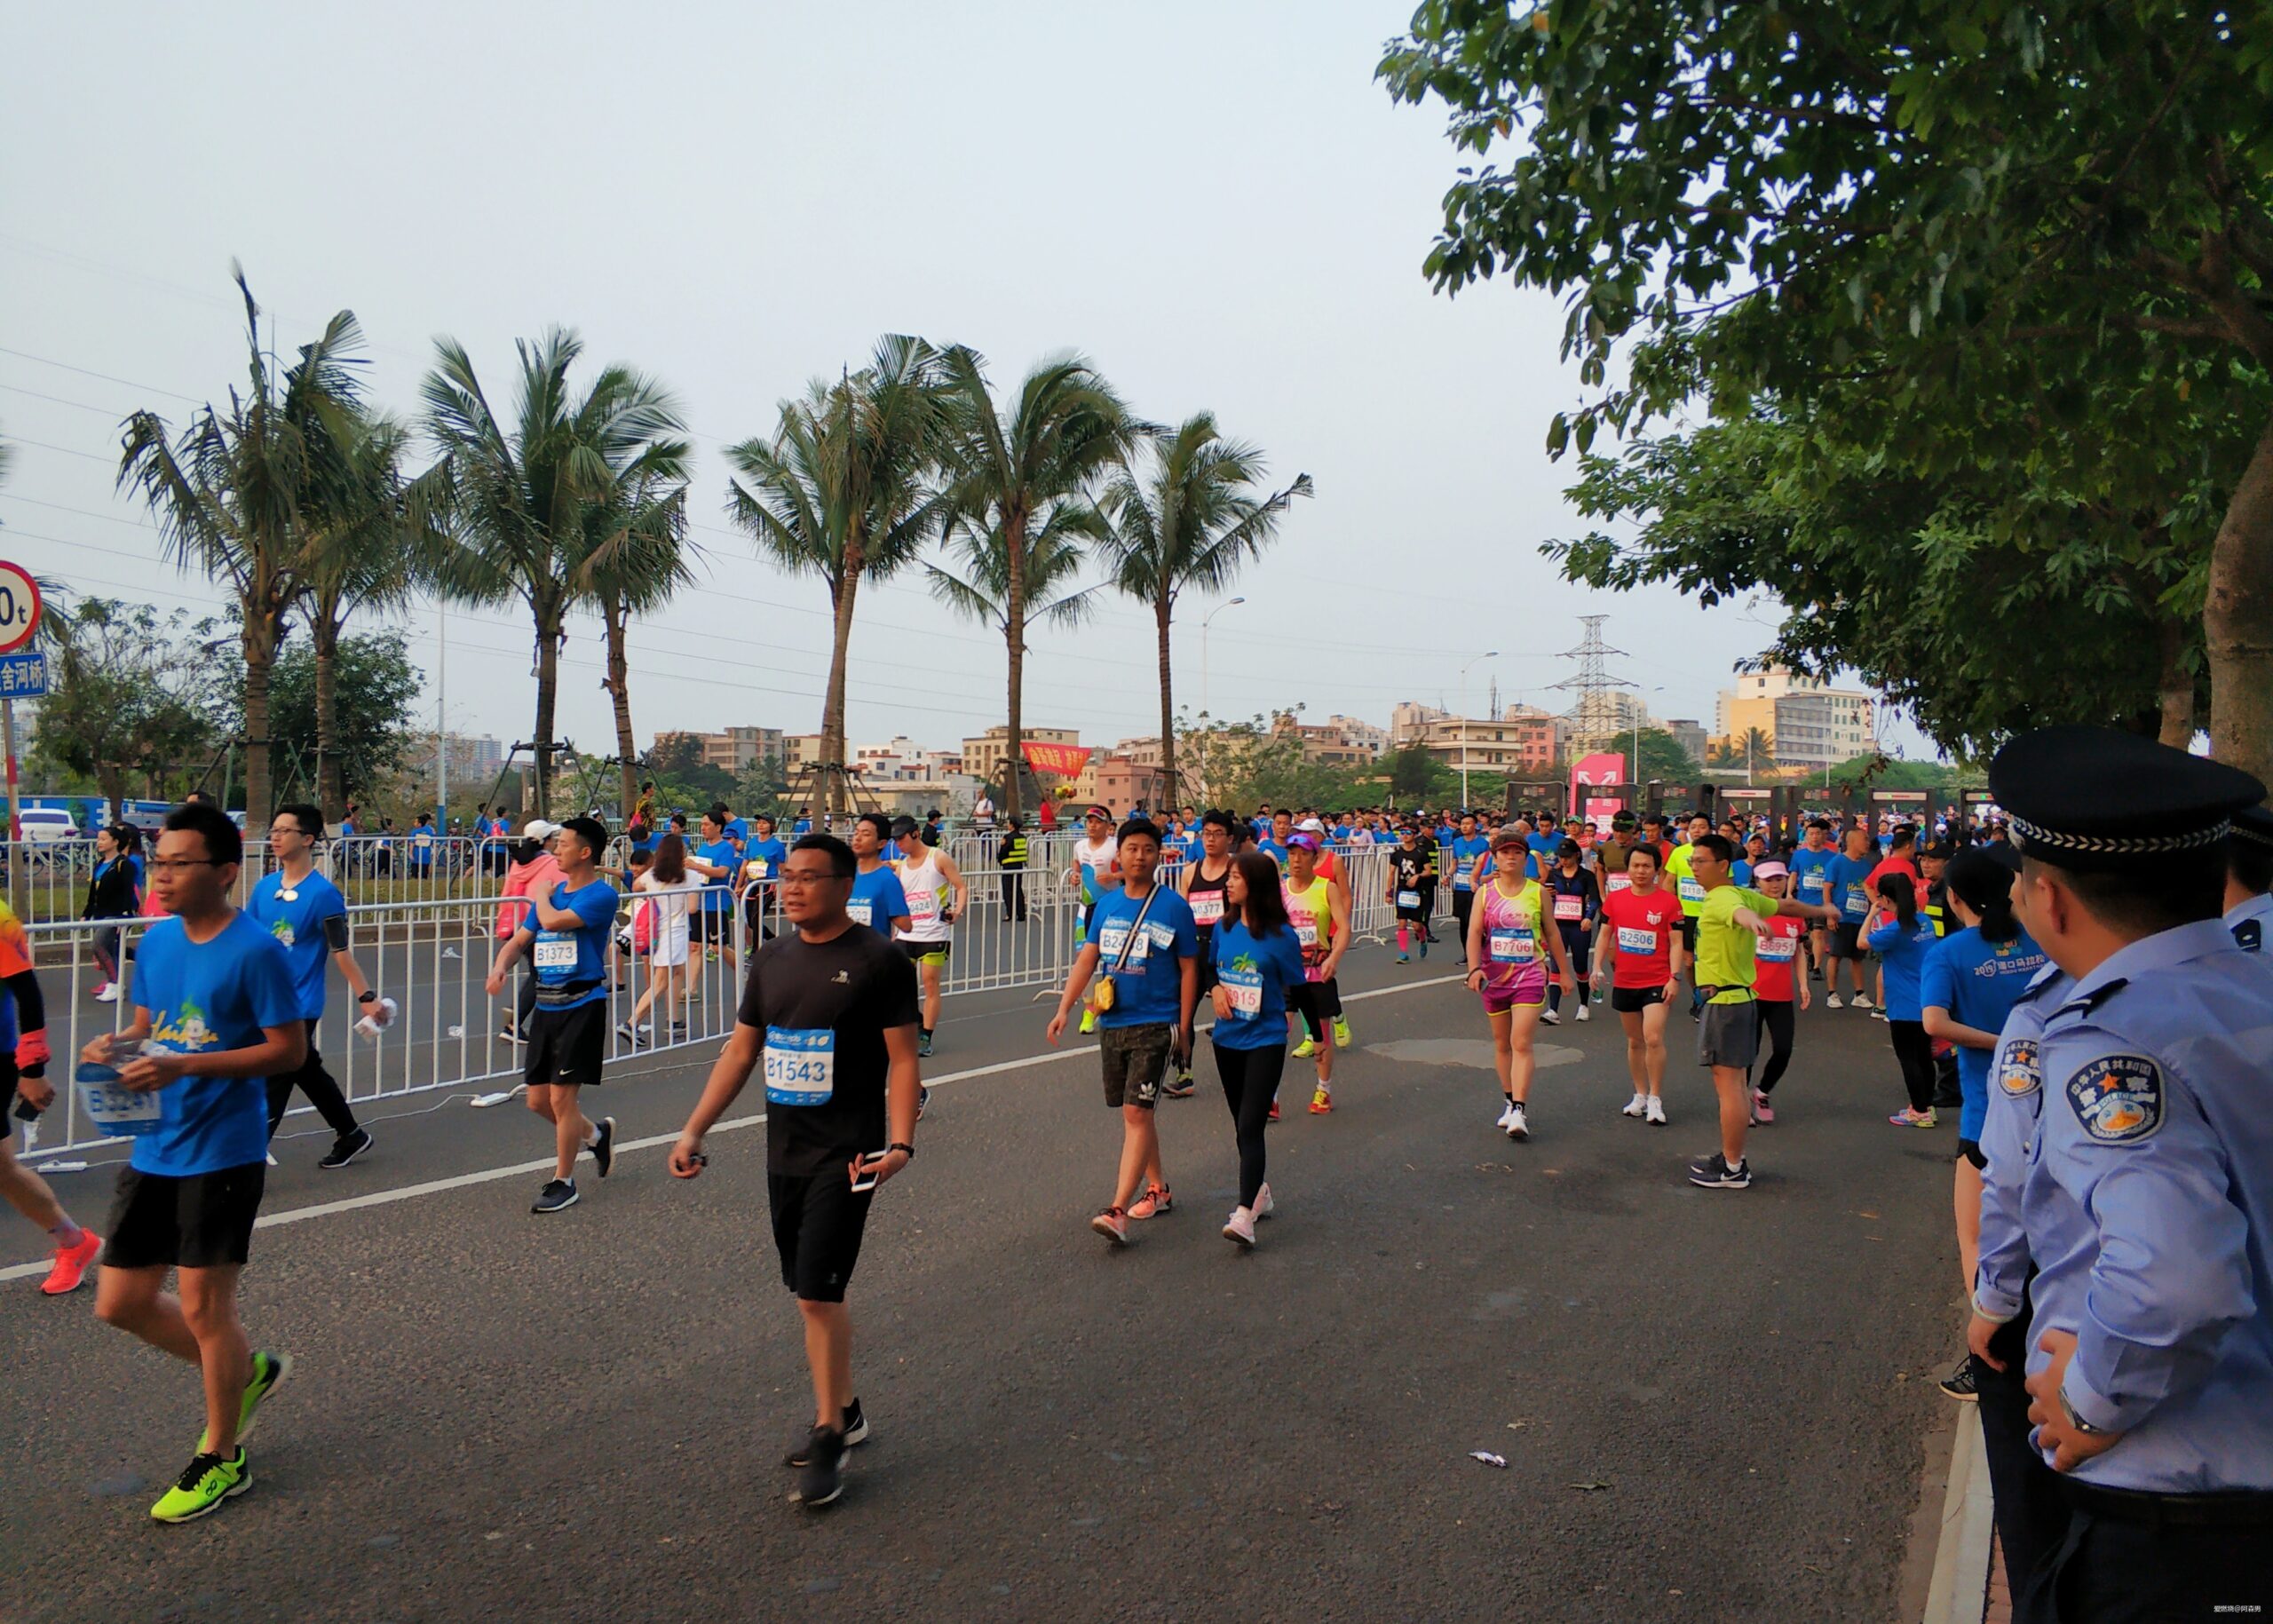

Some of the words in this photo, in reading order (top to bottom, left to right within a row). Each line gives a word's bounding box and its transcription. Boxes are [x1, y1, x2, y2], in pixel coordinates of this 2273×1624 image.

[0, 660, 43, 692] 舍河桥
[537, 946, 574, 962] B1373
[1494, 940, 1532, 953] B7706
[767, 1057, 825, 1081] B1543
[2071, 1059, 2151, 1097] 中华人民共和国
